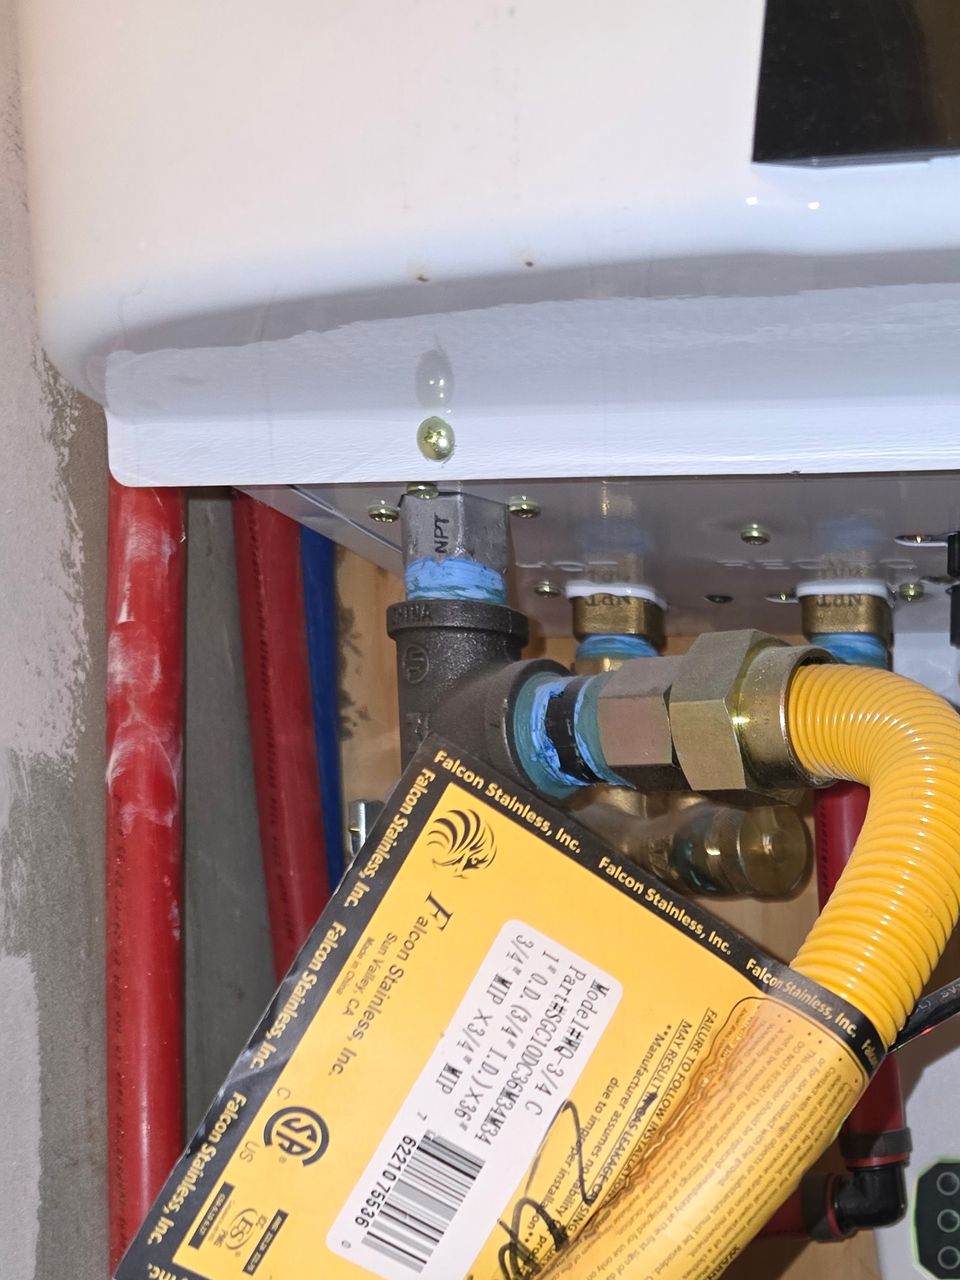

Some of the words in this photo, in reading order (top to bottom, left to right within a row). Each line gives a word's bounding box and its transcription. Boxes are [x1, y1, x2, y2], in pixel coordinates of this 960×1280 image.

[434, 512, 450, 553] NPT
[397, 766, 436, 818] Falcon
[433, 750, 486, 790] Falcon
[486, 783, 553, 837] Stainless,
[555, 828, 582, 853] Inc.
[358, 811, 409, 883] Stainless,
[342, 879, 371, 912] Inc.
[598, 856, 645, 894] Falcon
[645, 884, 706, 939] Stainless,
[708, 931, 732, 955] Inc.
[306, 919, 346, 973] Falcon
[377, 930, 398, 954] Sun
[400, 890, 454, 962] Falcon
[352, 952, 384, 994] Valley,
[263, 967, 318, 1044] Stainless,
[341, 993, 363, 1019] CA
[344, 960, 406, 1049] Stainless,
[746, 958, 783, 989] Falcon
[783, 982, 832, 1020] Stainless,
[834, 1012, 857, 1038] Inc.
[671, 1021, 692, 1048] MAY
[688, 1009, 719, 1055] FAILURE
[326, 1046, 356, 1082] Inc.
[602, 1076, 621, 1098] due
[649, 1049, 677, 1089] RESULT
[680, 1056, 694, 1072] TO
[206, 1090, 247, 1144] Falcon
[522, 1097, 545, 1117] C
[593, 1096, 609, 1114] to
[654, 1073, 685, 1120] FOLLOW
[238, 1140, 258, 1163] US
[587, 1108, 621, 1158] assumes
[599, 1130, 633, 1181] LEAKAGE
[163, 1138, 218, 1215] Stainless,
[380, 1133, 417, 1182] 62210
[353, 1180, 389, 1229] 75536
[145, 1211, 176, 1249] Inc.
